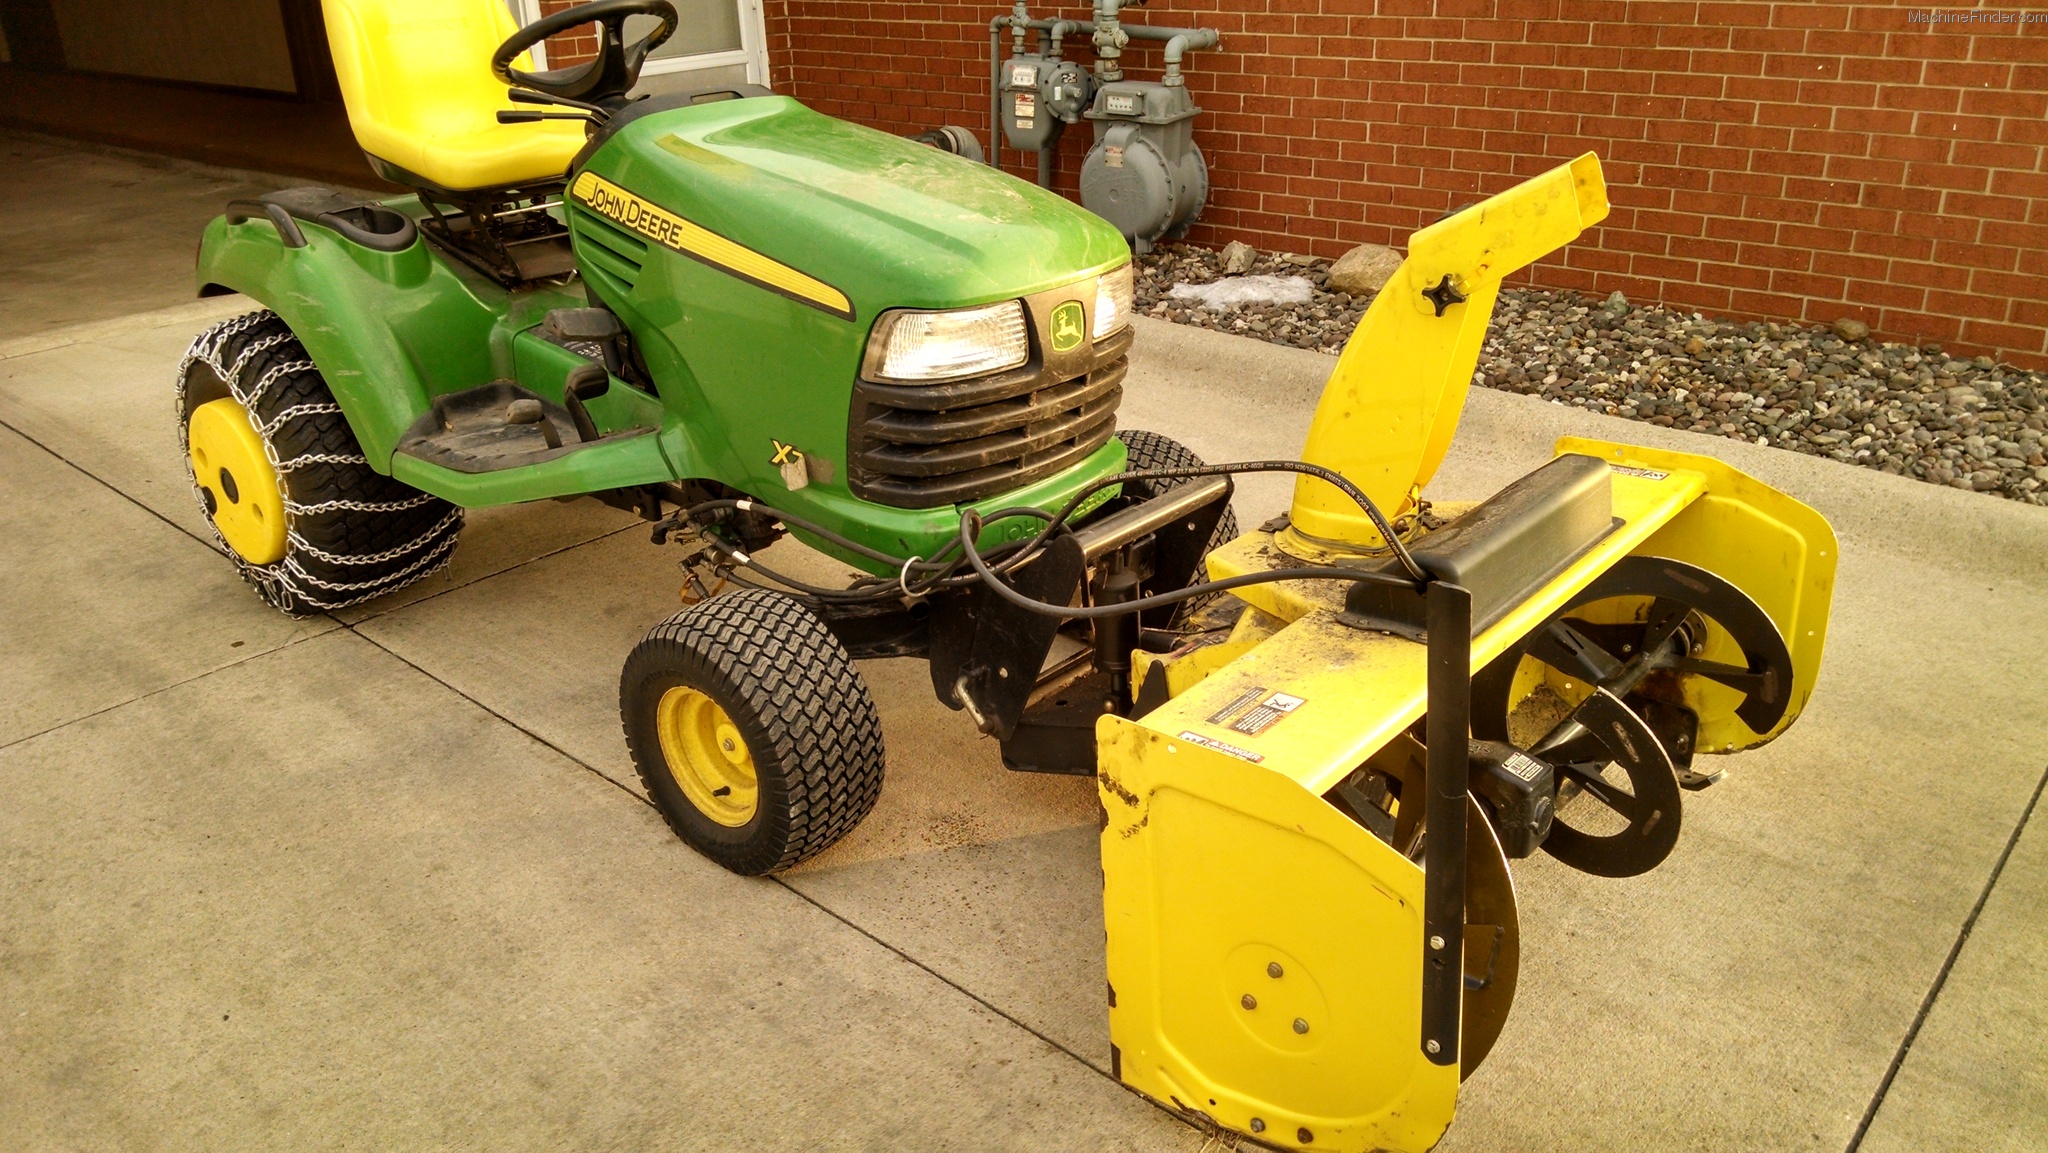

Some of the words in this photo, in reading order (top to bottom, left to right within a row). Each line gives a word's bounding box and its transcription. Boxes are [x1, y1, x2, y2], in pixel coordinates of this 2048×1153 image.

[588, 182, 626, 219] JOHN
[625, 199, 683, 246] DEERE
[1219, 742, 1262, 761] DANGER
